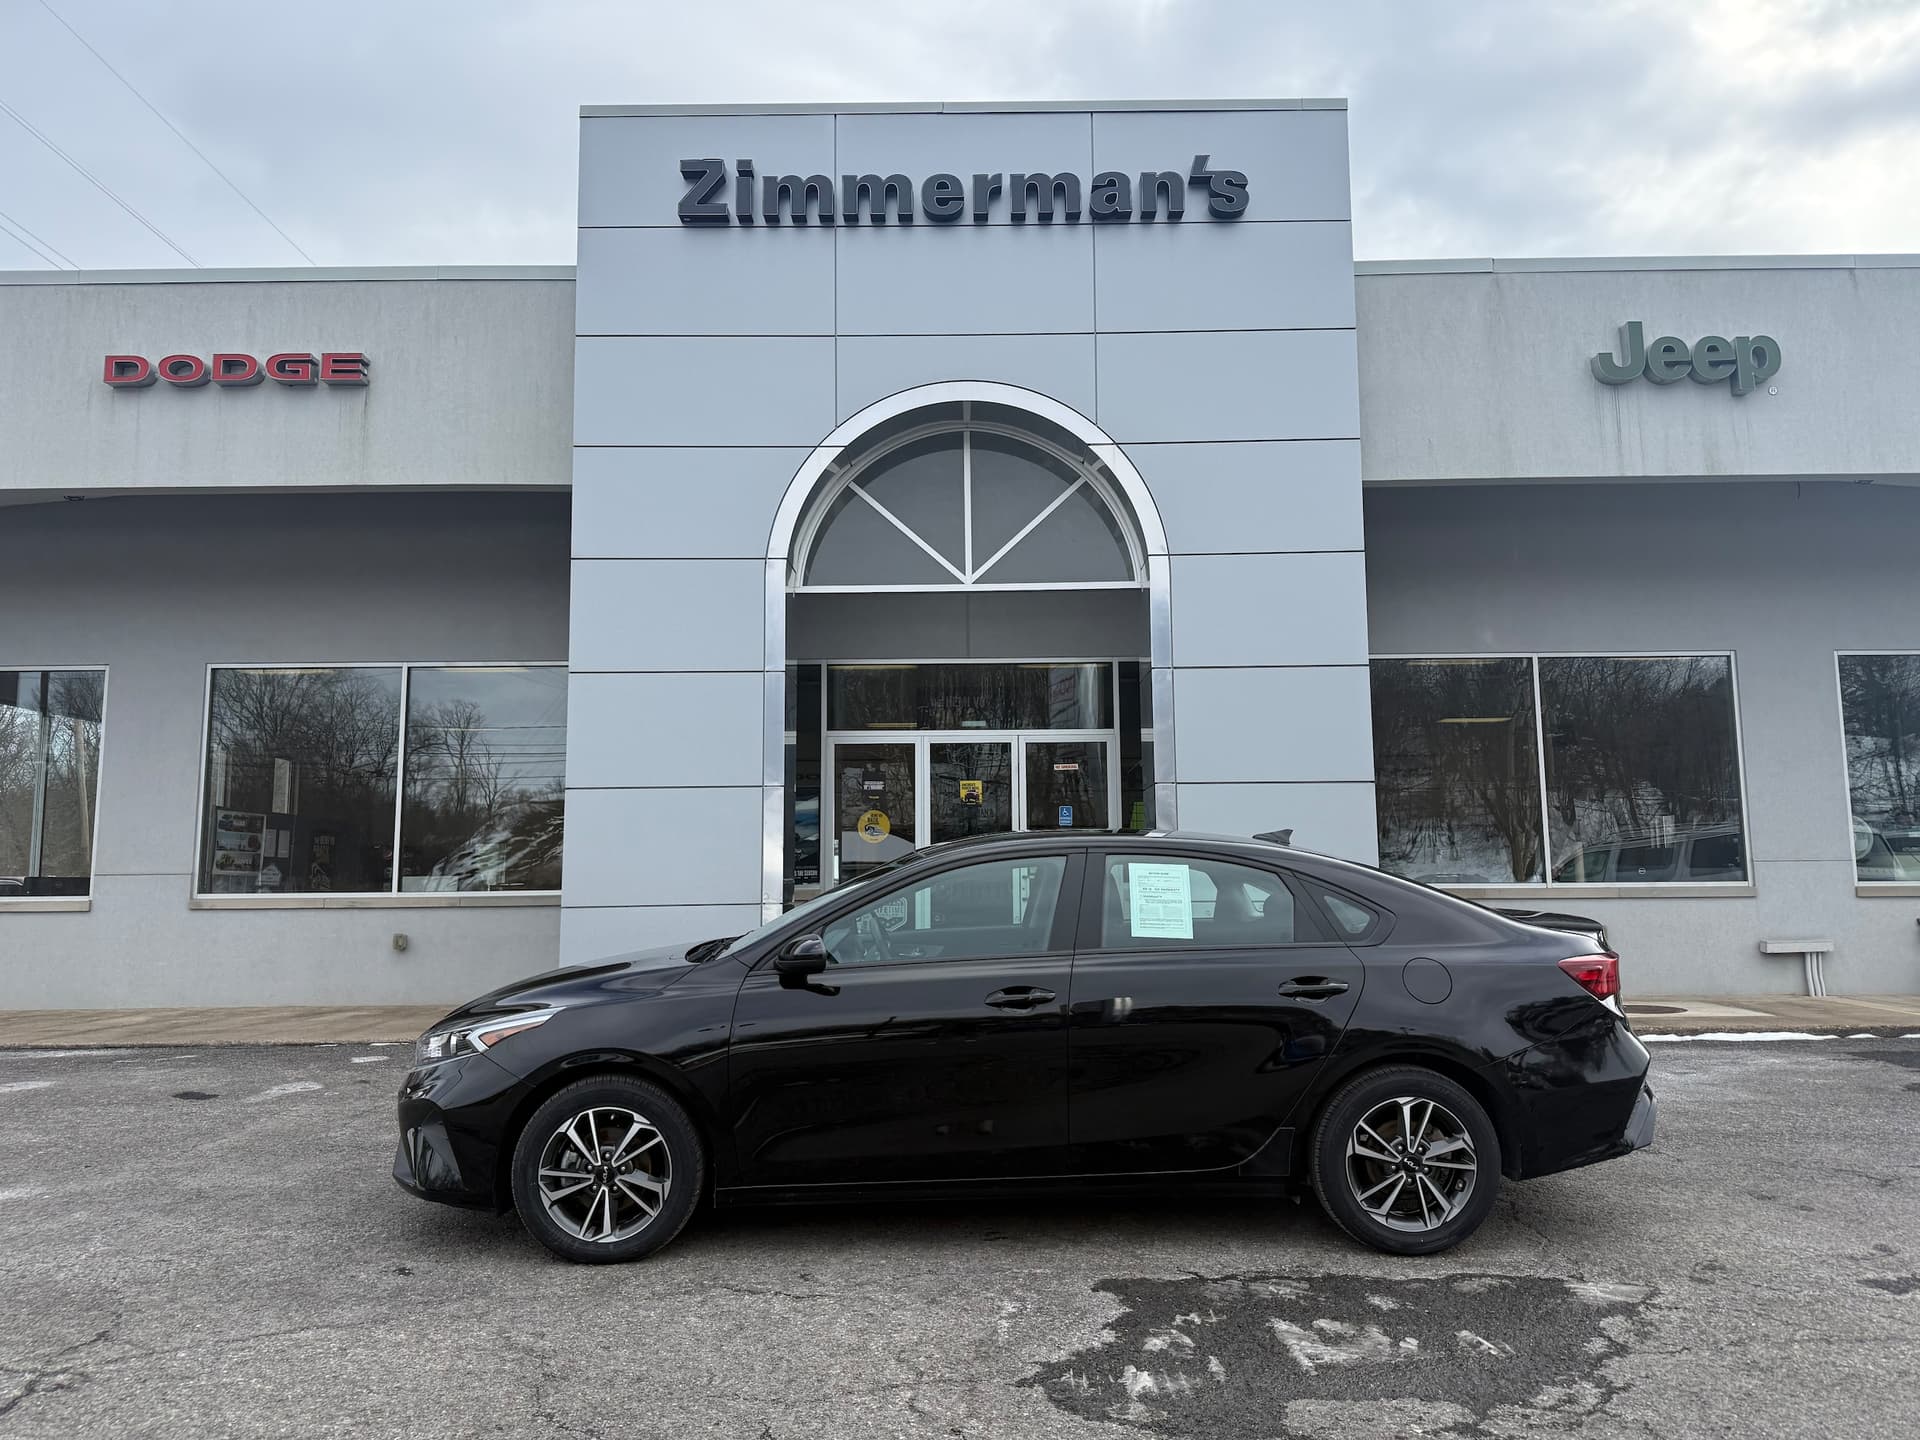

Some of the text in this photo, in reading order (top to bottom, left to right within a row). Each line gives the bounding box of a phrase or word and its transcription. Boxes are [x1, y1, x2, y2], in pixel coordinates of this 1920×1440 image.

[677, 154, 1249, 224] Zimmerman's
[103, 353, 369, 387] DODGE
[1591, 321, 1782, 397] Jeep
